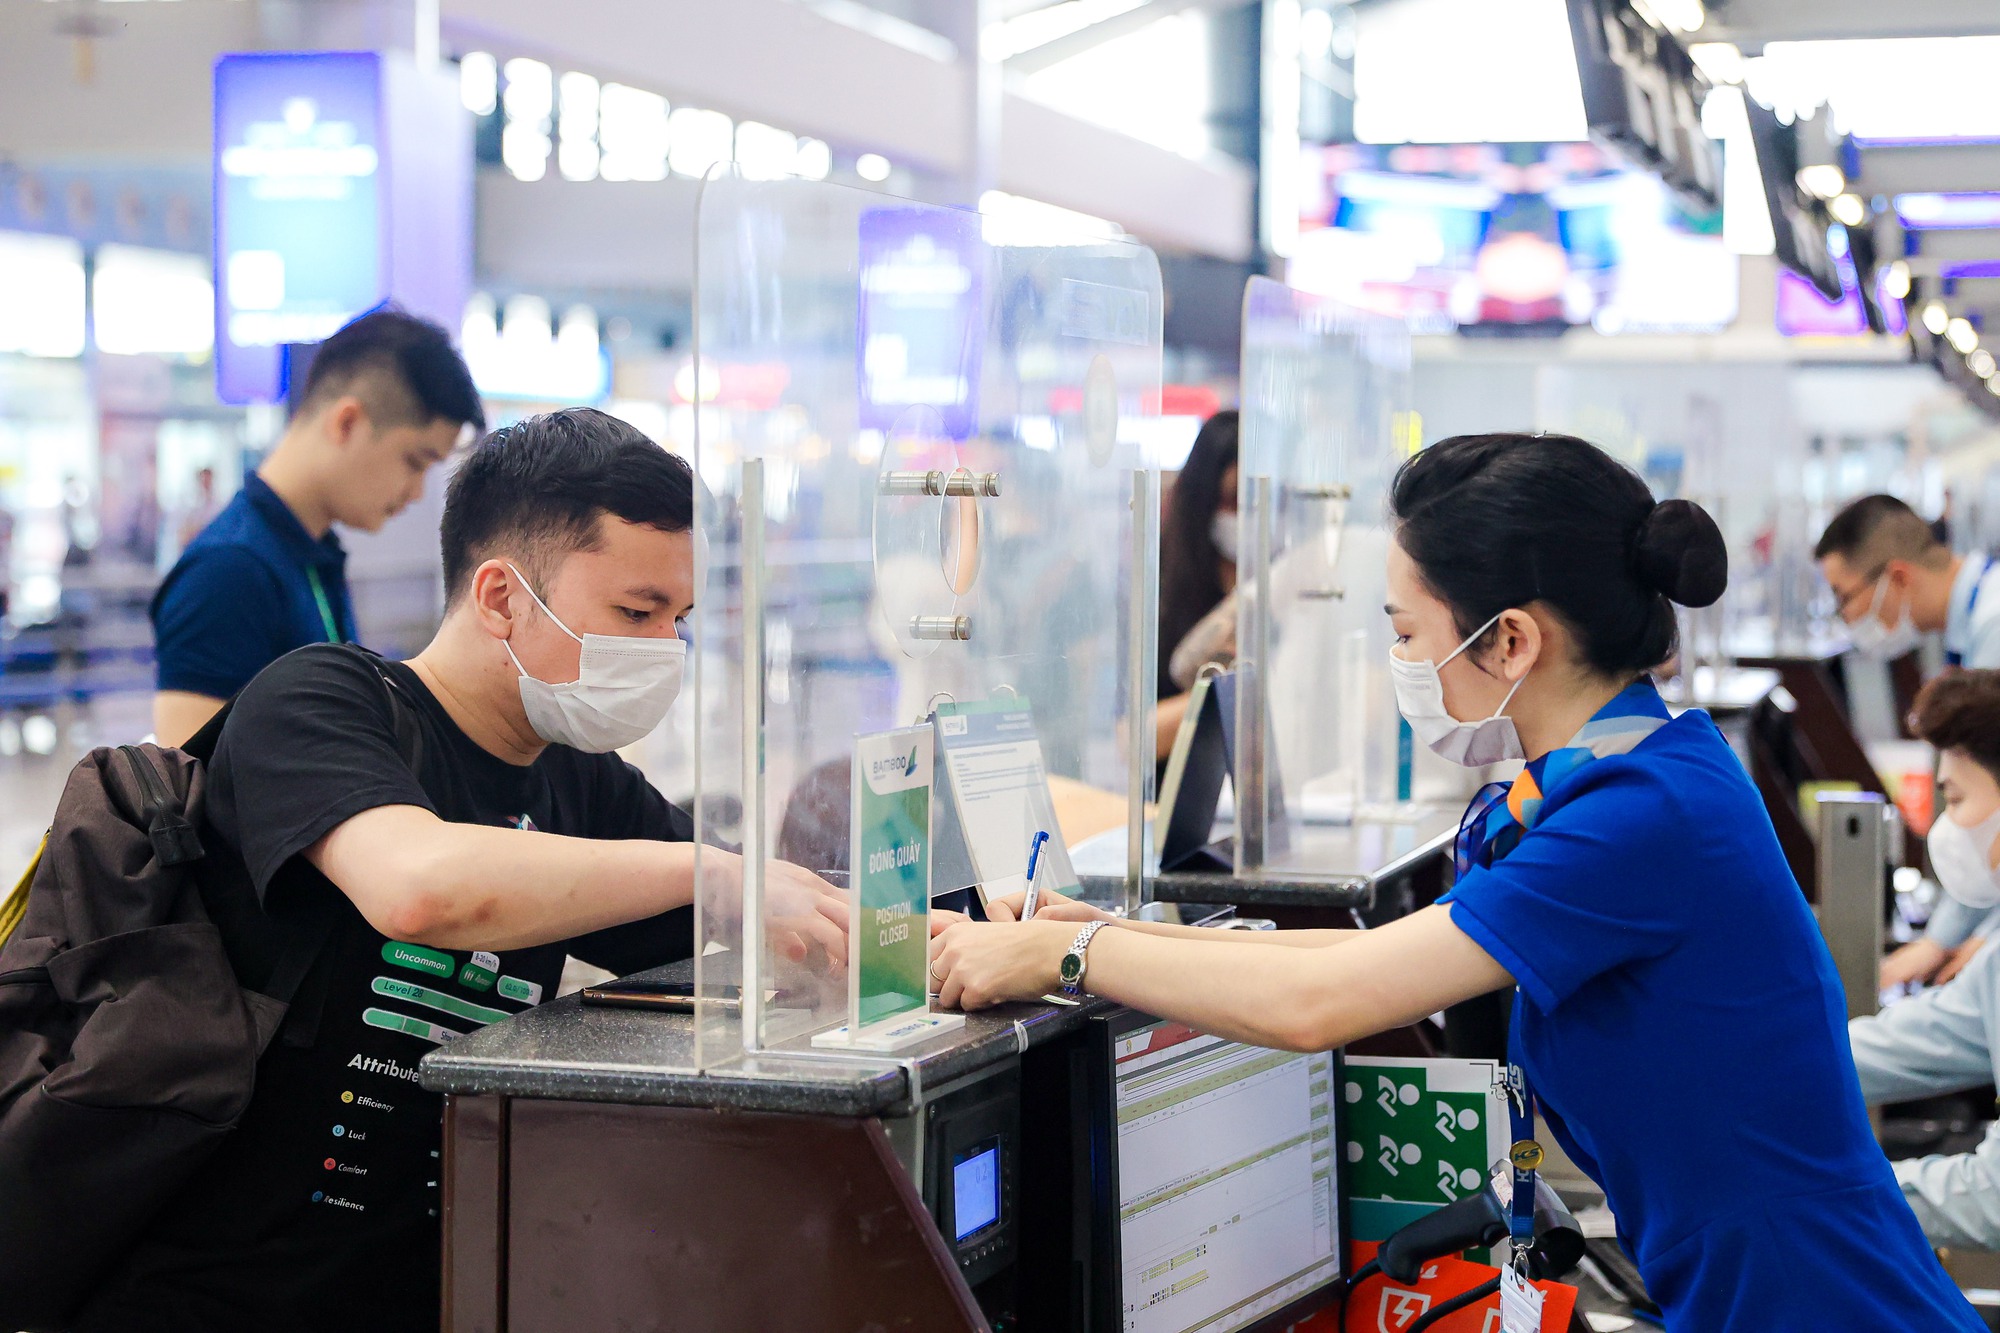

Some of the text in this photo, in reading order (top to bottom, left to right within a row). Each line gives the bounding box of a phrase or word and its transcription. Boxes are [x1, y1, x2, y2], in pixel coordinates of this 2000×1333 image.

[873, 756, 907, 774] BAMBOO
[876, 901, 911, 926] POSITION
[879, 923, 909, 947] CLOSED
[394, 949, 447, 971] Uncommon
[383, 981, 424, 998] Level 28
[347, 1053, 419, 1083] Attribute
[356, 1096, 395, 1113] Efficiency
[348, 1130, 366, 1141] Luck
[338, 1163, 368, 1176] Comfort
[324, 1195, 365, 1212] Resilience
